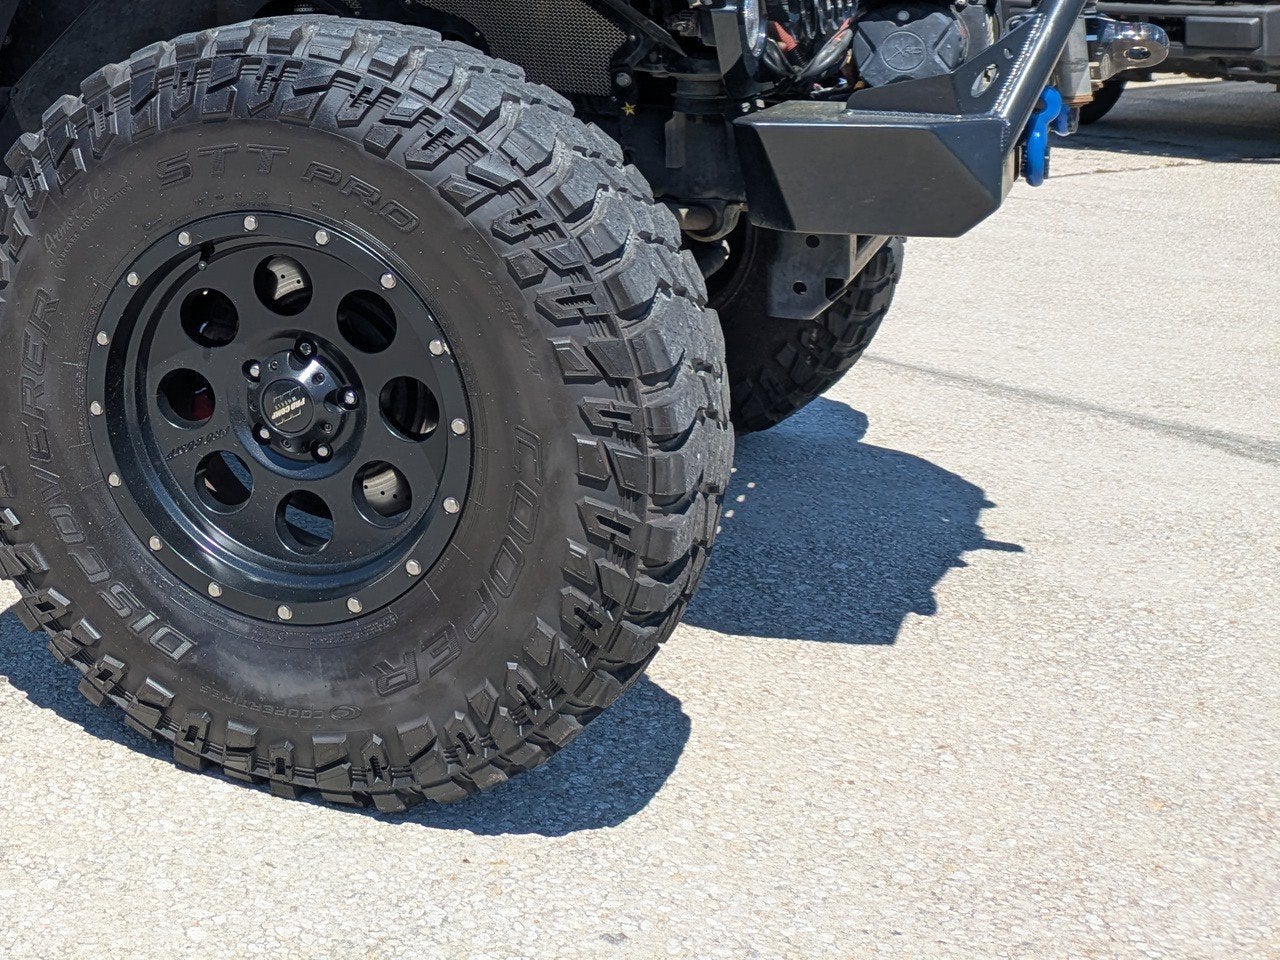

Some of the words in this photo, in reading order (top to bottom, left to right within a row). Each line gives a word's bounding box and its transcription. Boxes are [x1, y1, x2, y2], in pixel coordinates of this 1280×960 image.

[156, 142, 289, 190] STT
[299, 161, 422, 235] PRO
[14, 288, 197, 664] DISCOVERER
[375, 425, 545, 698] COOPER
